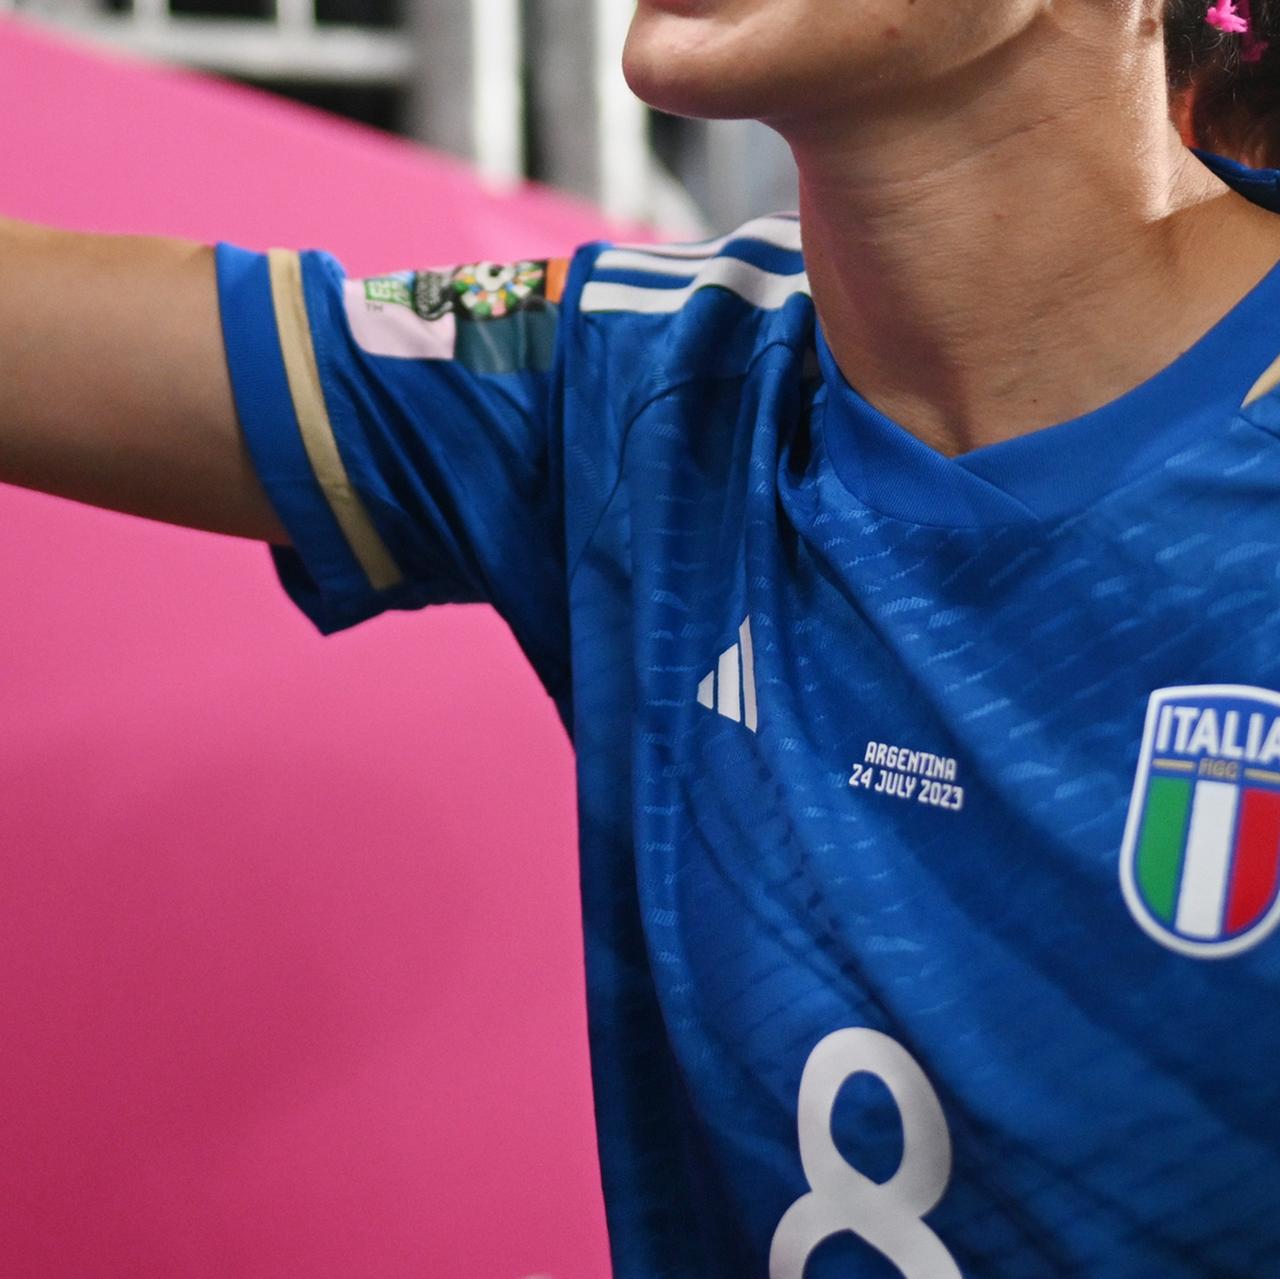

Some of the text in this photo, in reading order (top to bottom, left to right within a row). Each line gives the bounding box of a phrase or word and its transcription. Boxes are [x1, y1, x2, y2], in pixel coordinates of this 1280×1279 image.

[864, 740, 958, 781] ARGENTINA
[848, 763, 964, 811] 24 JULY 2023
[769, 1026, 964, 1279] 8
